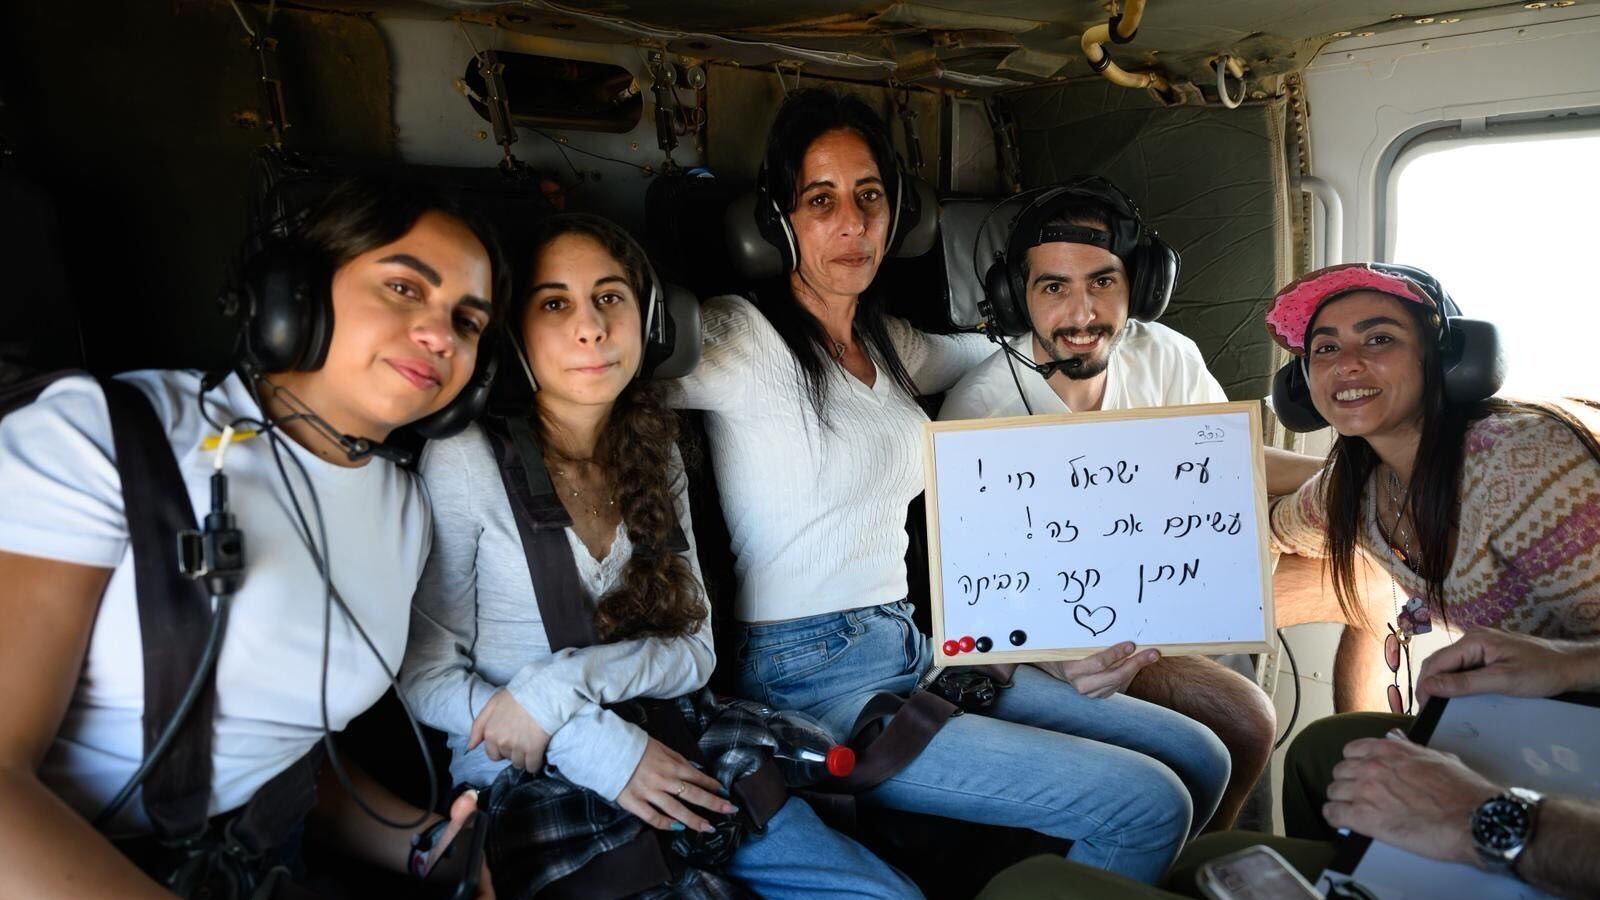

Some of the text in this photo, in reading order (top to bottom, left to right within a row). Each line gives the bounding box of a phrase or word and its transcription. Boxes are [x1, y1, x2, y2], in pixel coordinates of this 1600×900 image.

[1068, 454, 1139, 490] ישראל
[1174, 456, 1210, 485] עם
[1102, 513, 1144, 538] את
[1163, 511, 1242, 539] עשיתם
[957, 558, 1200, 606] מתן חזר הביתה
